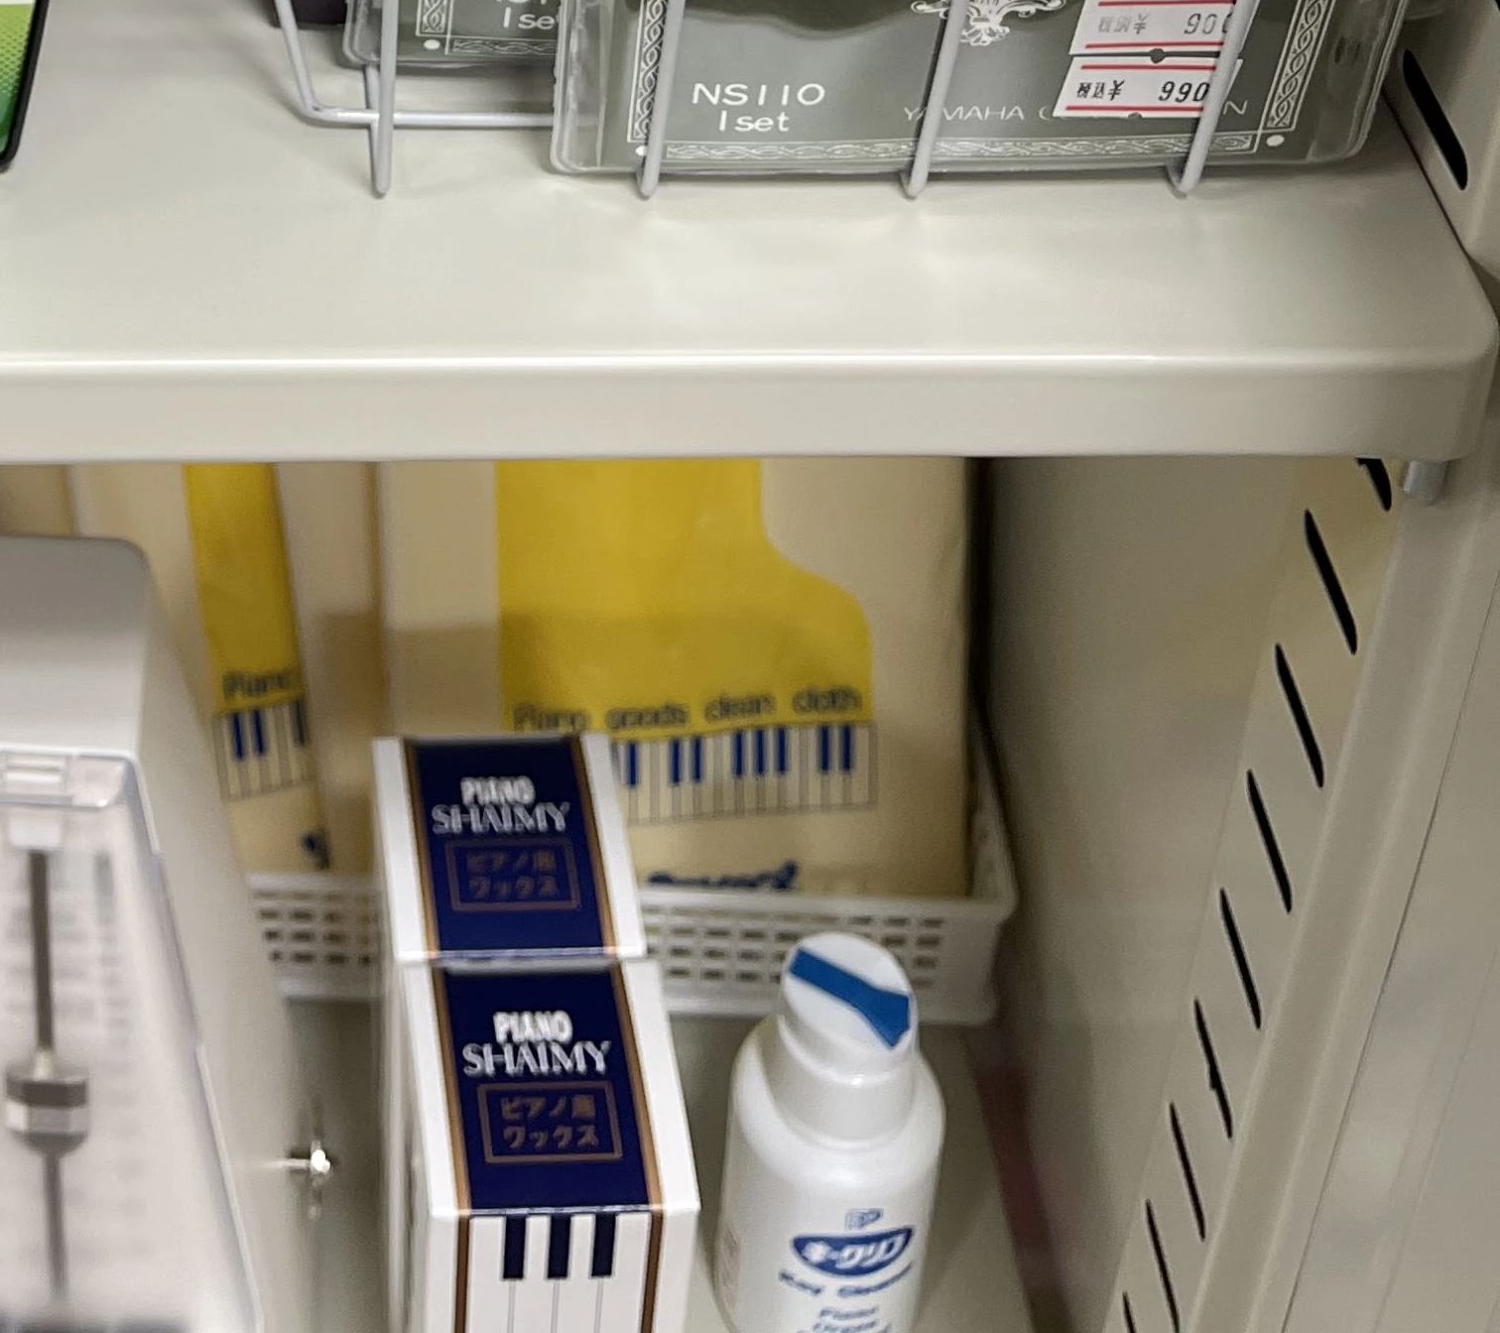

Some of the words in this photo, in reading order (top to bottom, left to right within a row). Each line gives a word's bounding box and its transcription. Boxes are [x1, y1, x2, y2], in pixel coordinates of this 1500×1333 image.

[503, 6, 555, 30] 1se
[691, 82, 826, 106] NS110
[1158, 80, 1210, 104] 990
[460, 775, 536, 806] PIANO
[493, 1010, 574, 1043] PIANO
